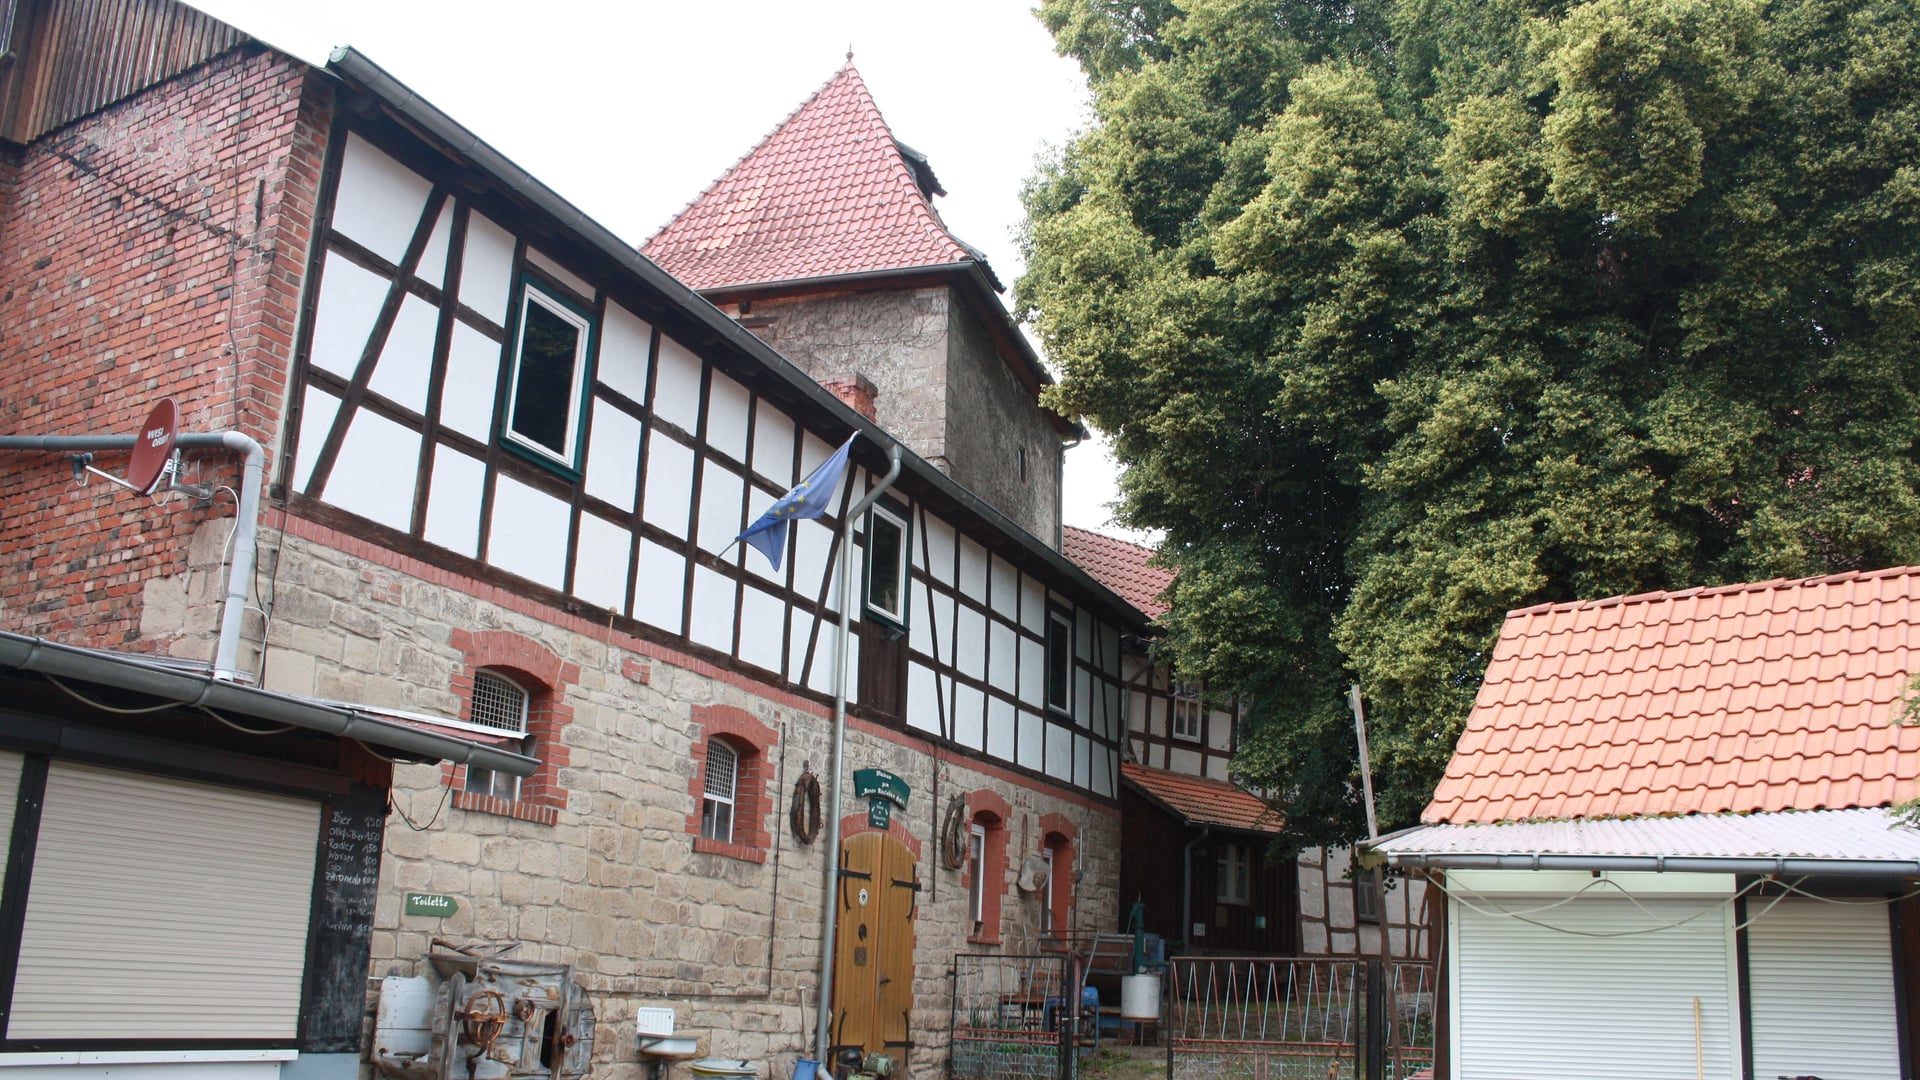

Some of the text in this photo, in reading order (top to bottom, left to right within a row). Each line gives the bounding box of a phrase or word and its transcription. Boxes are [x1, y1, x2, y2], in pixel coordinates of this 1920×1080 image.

[147, 427, 164, 440] WISI
[332, 810, 352, 825] Bier
[412, 895, 449, 907] Toilette
